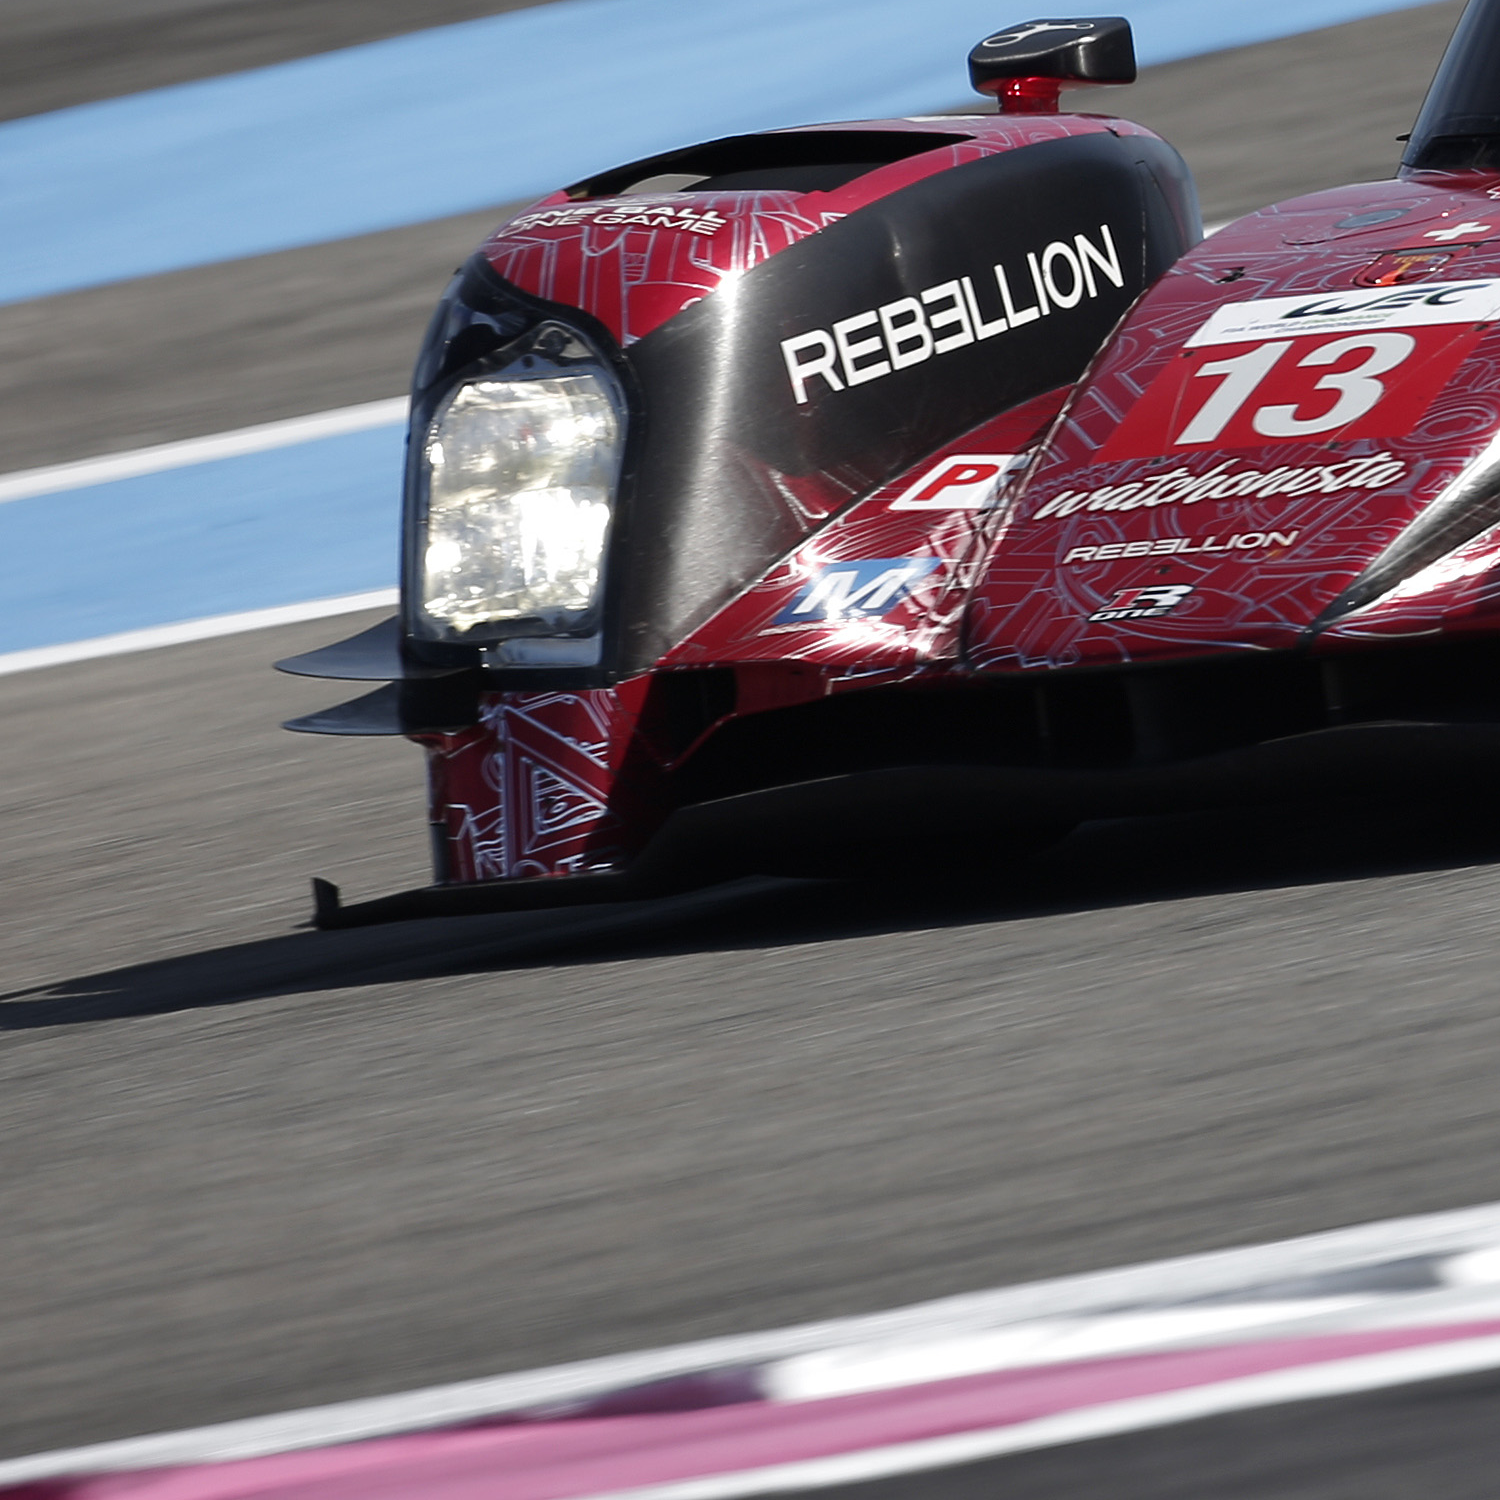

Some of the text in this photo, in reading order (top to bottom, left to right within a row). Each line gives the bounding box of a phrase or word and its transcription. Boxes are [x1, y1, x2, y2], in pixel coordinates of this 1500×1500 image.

[593, 213, 724, 236] GAME
[780, 224, 1124, 404] REBELLION
[1280, 283, 1492, 319] WEC
[1175, 332, 1416, 445] 13
[1033, 451, 1406, 520] watchonista
[1062, 531, 1299, 564] REBELLION
